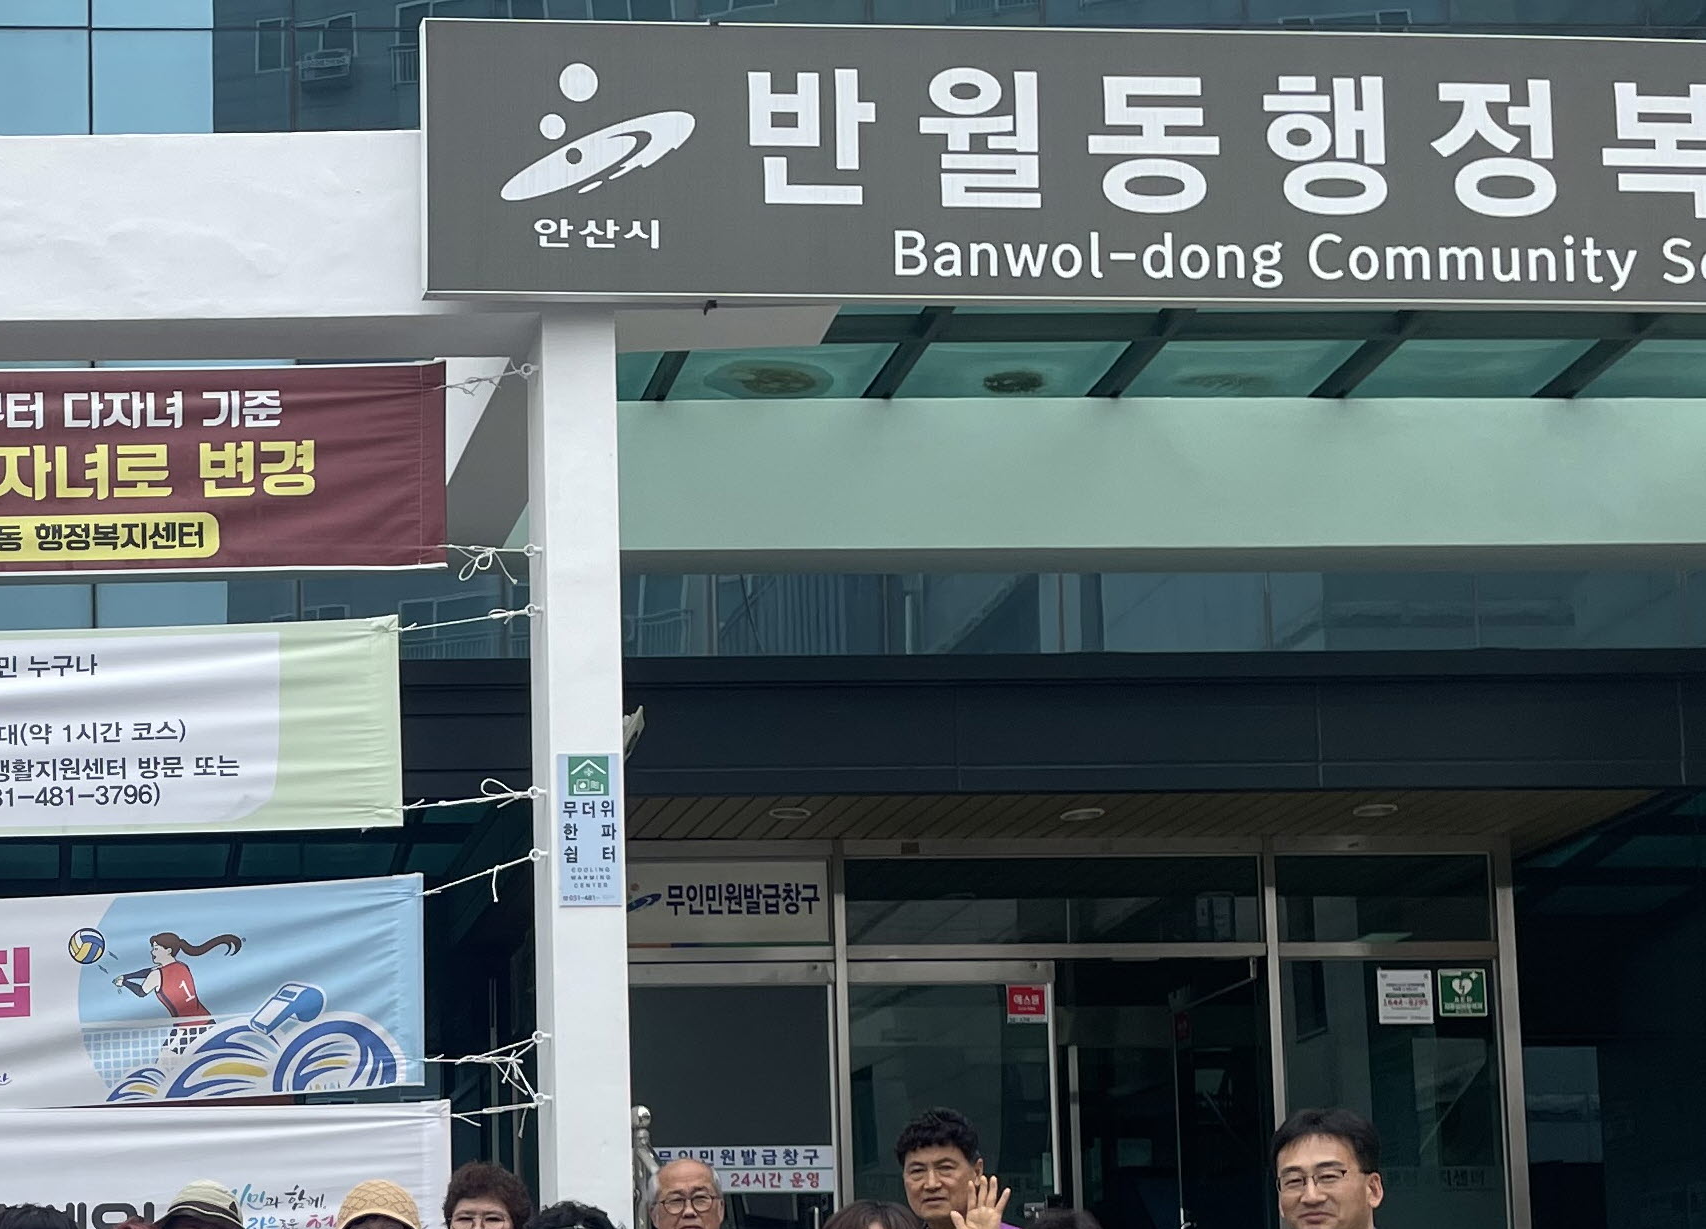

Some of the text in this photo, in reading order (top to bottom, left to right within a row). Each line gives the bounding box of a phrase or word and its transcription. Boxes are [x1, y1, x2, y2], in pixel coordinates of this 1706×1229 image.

[747, 66, 1706, 219] 반월동행정복
[534, 218, 660, 250] 안산시
[894, 230, 1284, 289] Banwol-dong
[1308, 232, 1638, 292] Community
[62, 389, 184, 430] 다자녀
[202, 388, 283, 429] 기준
[198, 438, 316, 499] 변경
[34, 520, 205, 552] 행정복지센터
[27, 653, 98, 678] 누구나
[62, 721, 123, 745] 1시간
[131, 718, 187, 743] 코스)
[138, 755, 185, 780] 방문
[193, 754, 241, 778] 또는
[562, 800, 615, 819] 무더위
[666, 882, 821, 917] 무인민원발급창구
[730, 1171, 821, 1189] 24시간 운영
